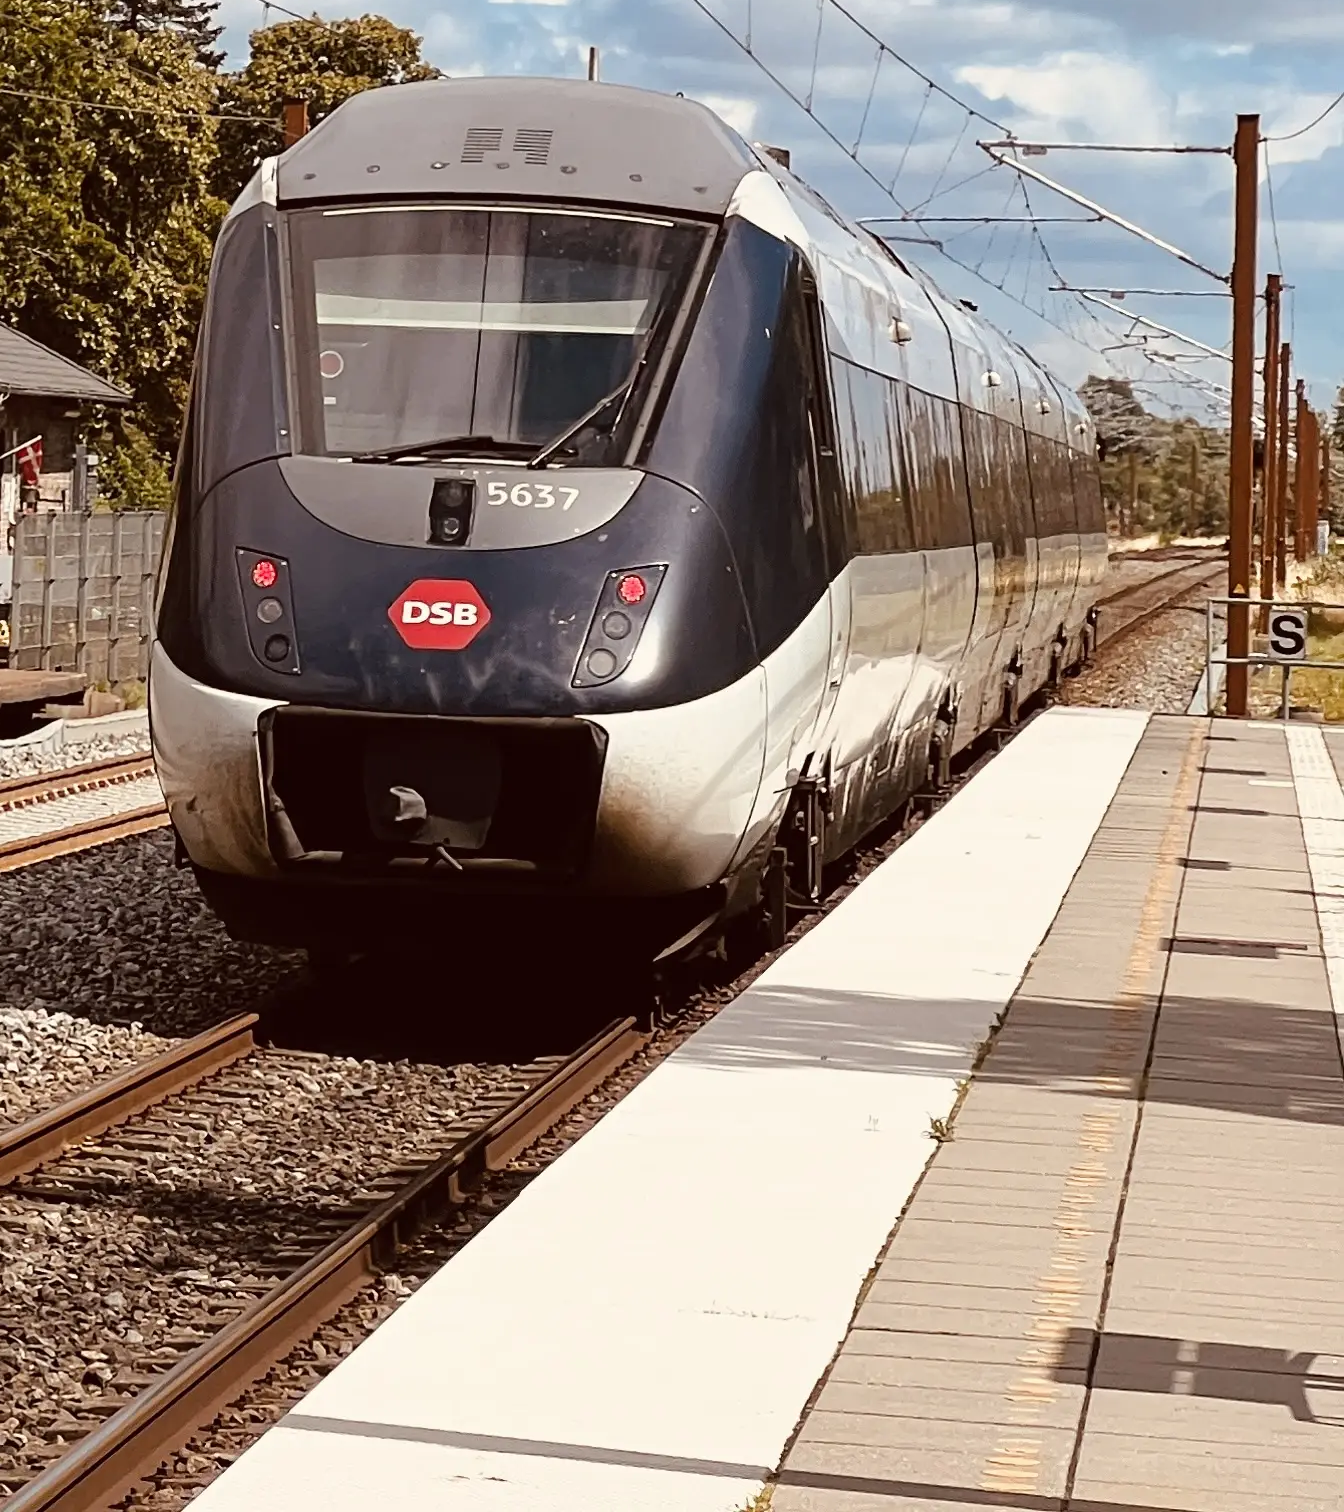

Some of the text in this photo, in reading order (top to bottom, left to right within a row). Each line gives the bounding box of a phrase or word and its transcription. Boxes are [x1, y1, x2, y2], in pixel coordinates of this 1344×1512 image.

[487, 482, 580, 511] 5637
[401, 600, 478, 626] DSB
[1270, 614, 1305, 655] S
